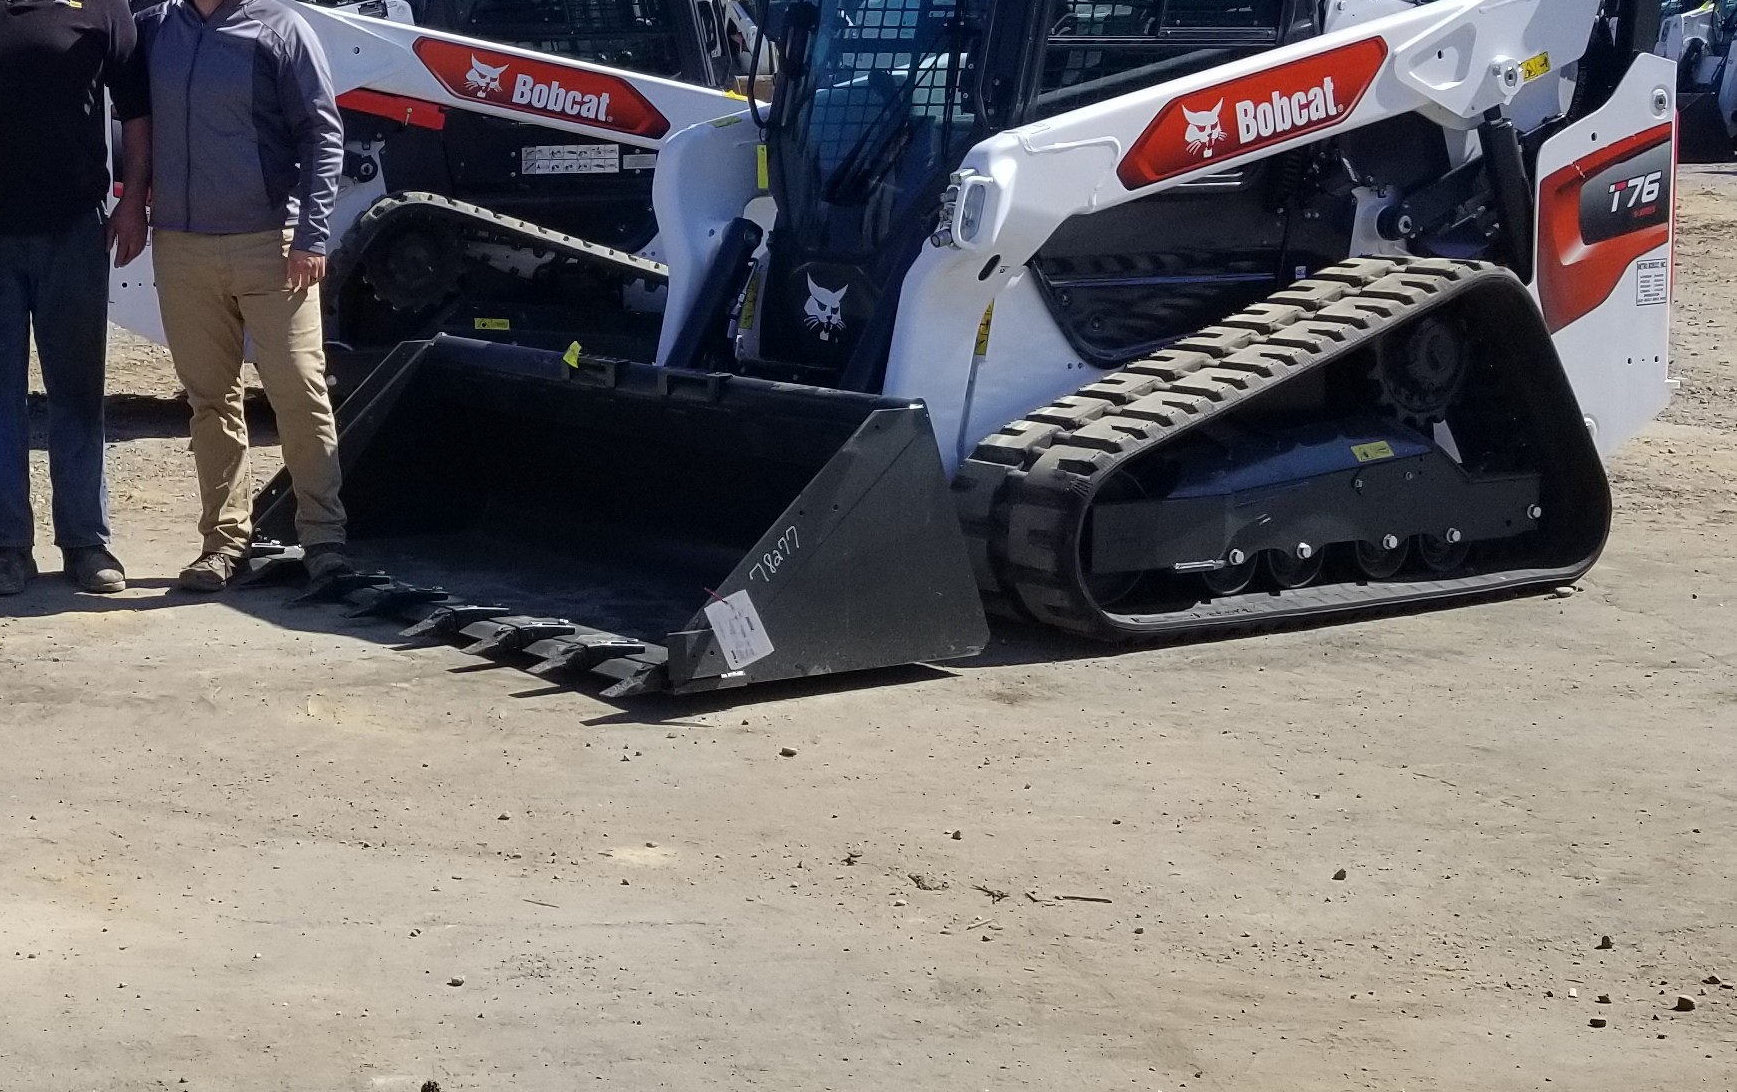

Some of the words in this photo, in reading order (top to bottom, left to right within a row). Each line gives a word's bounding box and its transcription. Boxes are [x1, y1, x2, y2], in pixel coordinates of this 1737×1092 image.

[512, 73, 610, 122] Bobcat
[1235, 76, 1338, 144] Bobcat
[1608, 171, 1662, 213] T76
[749, 525, 800, 583] 78277
